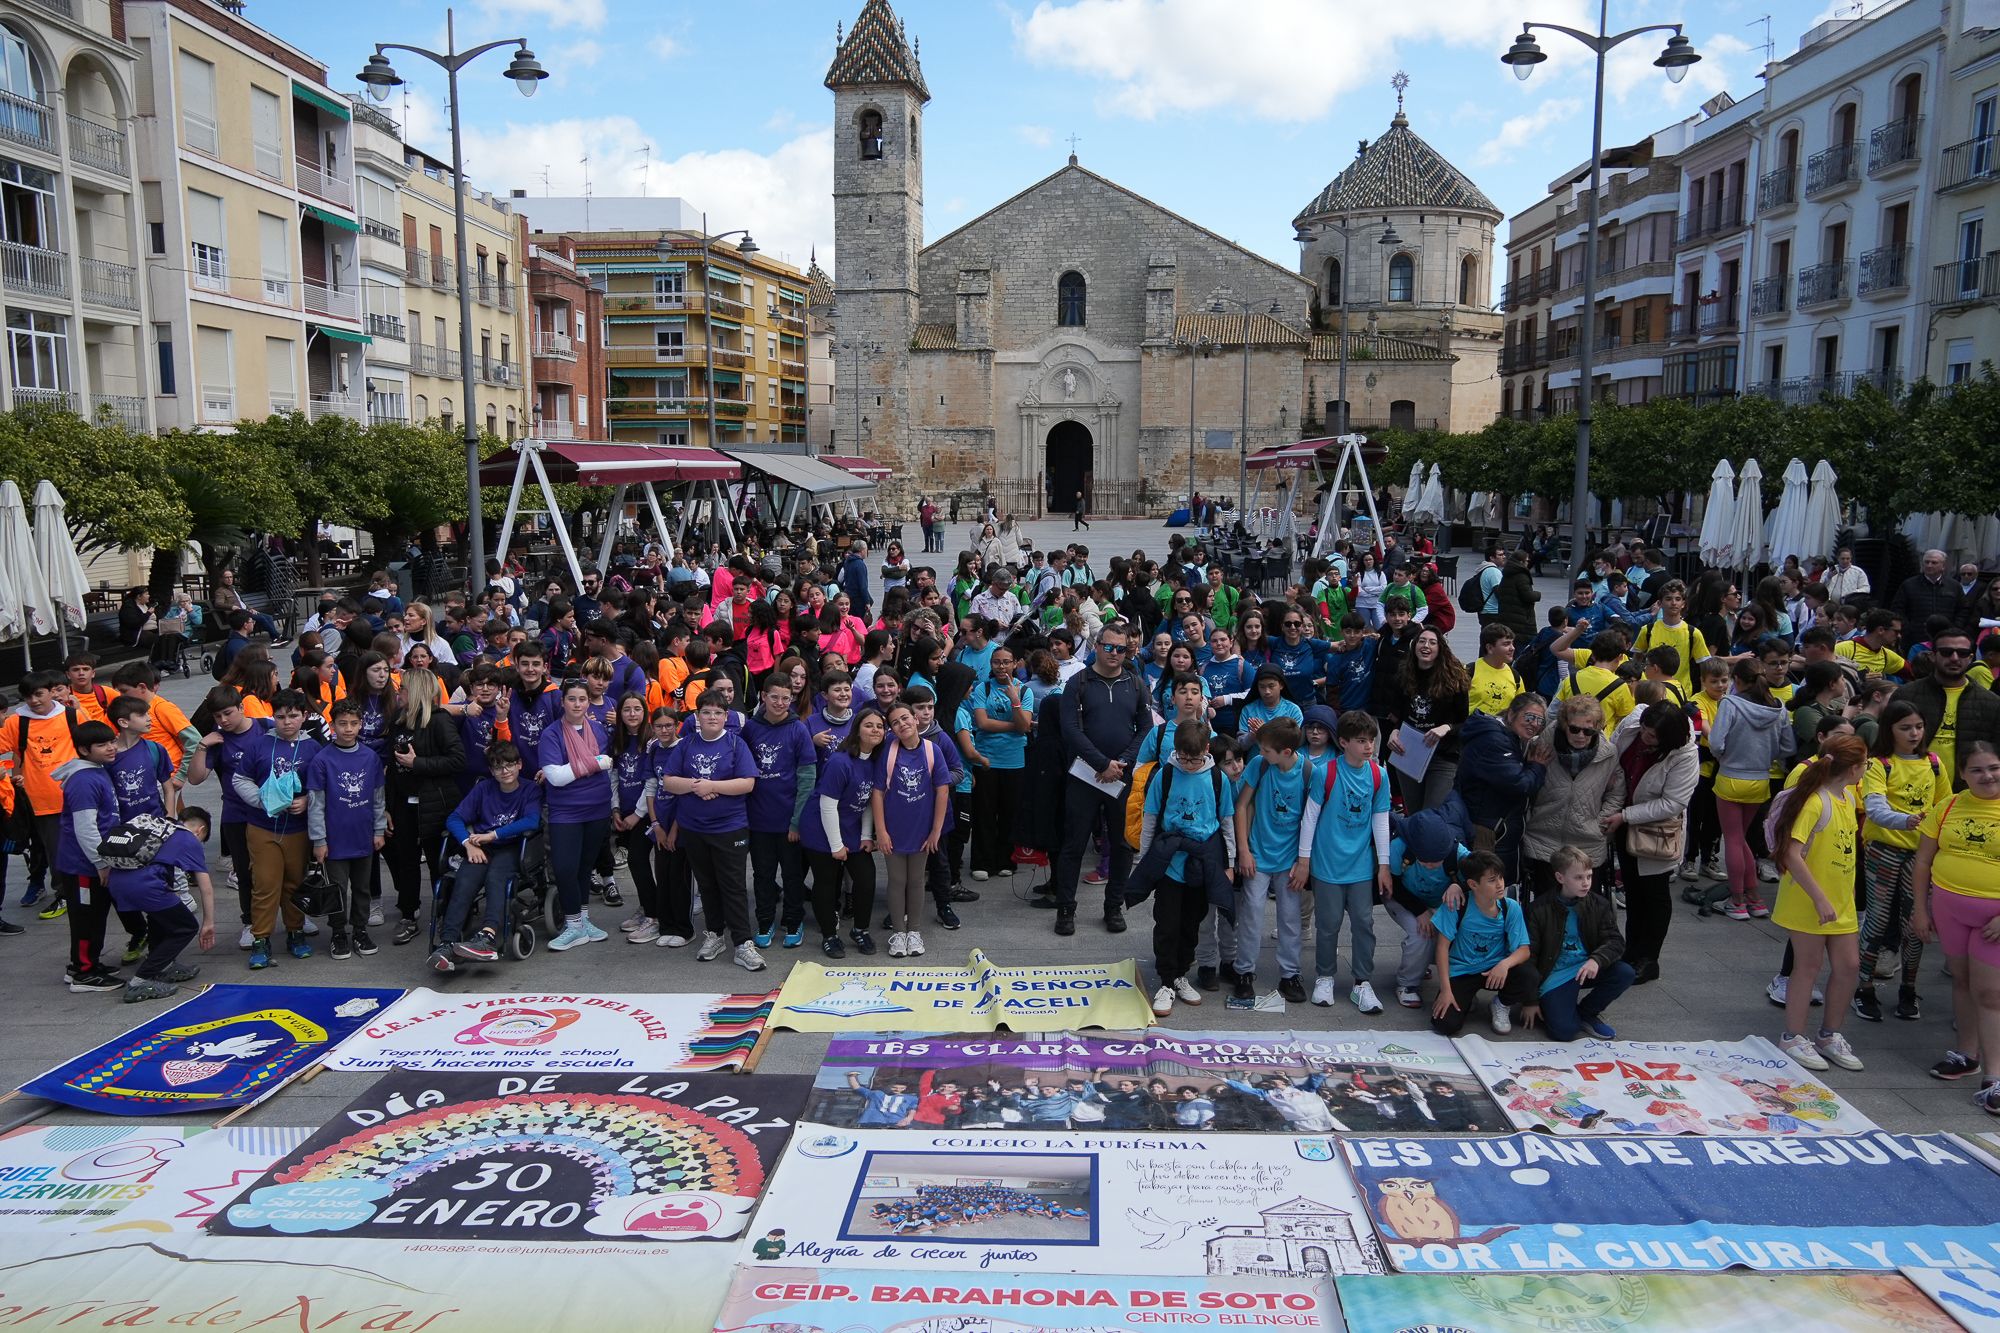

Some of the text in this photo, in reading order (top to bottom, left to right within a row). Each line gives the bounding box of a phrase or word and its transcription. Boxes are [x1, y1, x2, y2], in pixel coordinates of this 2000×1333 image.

[107, 835, 130, 845] PUMA
[824, 970, 888, 979] Colegio
[1033, 968, 1107, 977] Primaria
[1012, 977, 1132, 992] SEÑORA
[933, 990, 1090, 1009] DE AACELI
[365, 995, 668, 1041] C.E.I.P. VIRGEN DEL VALLE
[505, 1048, 551, 1057] make
[561, 1048, 620, 1057] school
[866, 1042, 930, 1055] IES
[1584, 1038, 1617, 1050] del
[1629, 1042, 1687, 1052] CEIP
[1695, 1050, 1719, 1059] EL
[1728, 1054, 1789, 1069] PRADO
[339, 1056, 635, 1069] Juntos, hacemos escuela
[1201, 1054, 1296, 1064] LUCENA
[1573, 1059, 1697, 1082] PAZ
[133, 1089, 190, 1099] LUCENA
[498, 1073, 564, 1096] DE
[617, 1073, 691, 1099] LA
[694, 1094, 792, 1136] PAZ
[931, 1136, 1208, 1151] COLEGIO LA PURÍSIMA
[1346, 1142, 1433, 1167] IES
[1449, 1135, 1602, 1167] JUAN
[1605, 1140, 1694, 1165] DE
[1126, 1158, 1145, 1171] No
[1149, 1159, 1183, 1173] basta
[1185, 1163, 1206, 1171] con
[1210, 1158, 1248, 1171] hablar
[1251, 1160, 1264, 1171] de
[451, 1161, 552, 1192] 30
[1143, 1168, 1171, 1182] Uno
[1174, 1169, 1201, 1180] debe
[1250, 1170, 1270, 1184] ella
[1273, 1176, 1284, 1186] y
[0, 1184, 155, 1200] CERVANTES
[1136, 1179, 1183, 1194] trabajar
[1186, 1183, 1212, 1195] para
[262, 1197, 364, 1209] San José
[232, 1208, 369, 1221] de Calasanz
[371, 1197, 583, 1228] ENERO
[786, 1240, 1038, 1268] Alegría de crecer juntos
[1385, 1235, 1996, 1270] POR LA CULTURA Y LA
[755, 1283, 1316, 1311] CEIP. BARAHONA DE SOTO
[166, 1295, 243, 1326] de
[233, 1294, 461, 1333] Aras
[1125, 1312, 1321, 1327] CENTRO BILINGÜE
